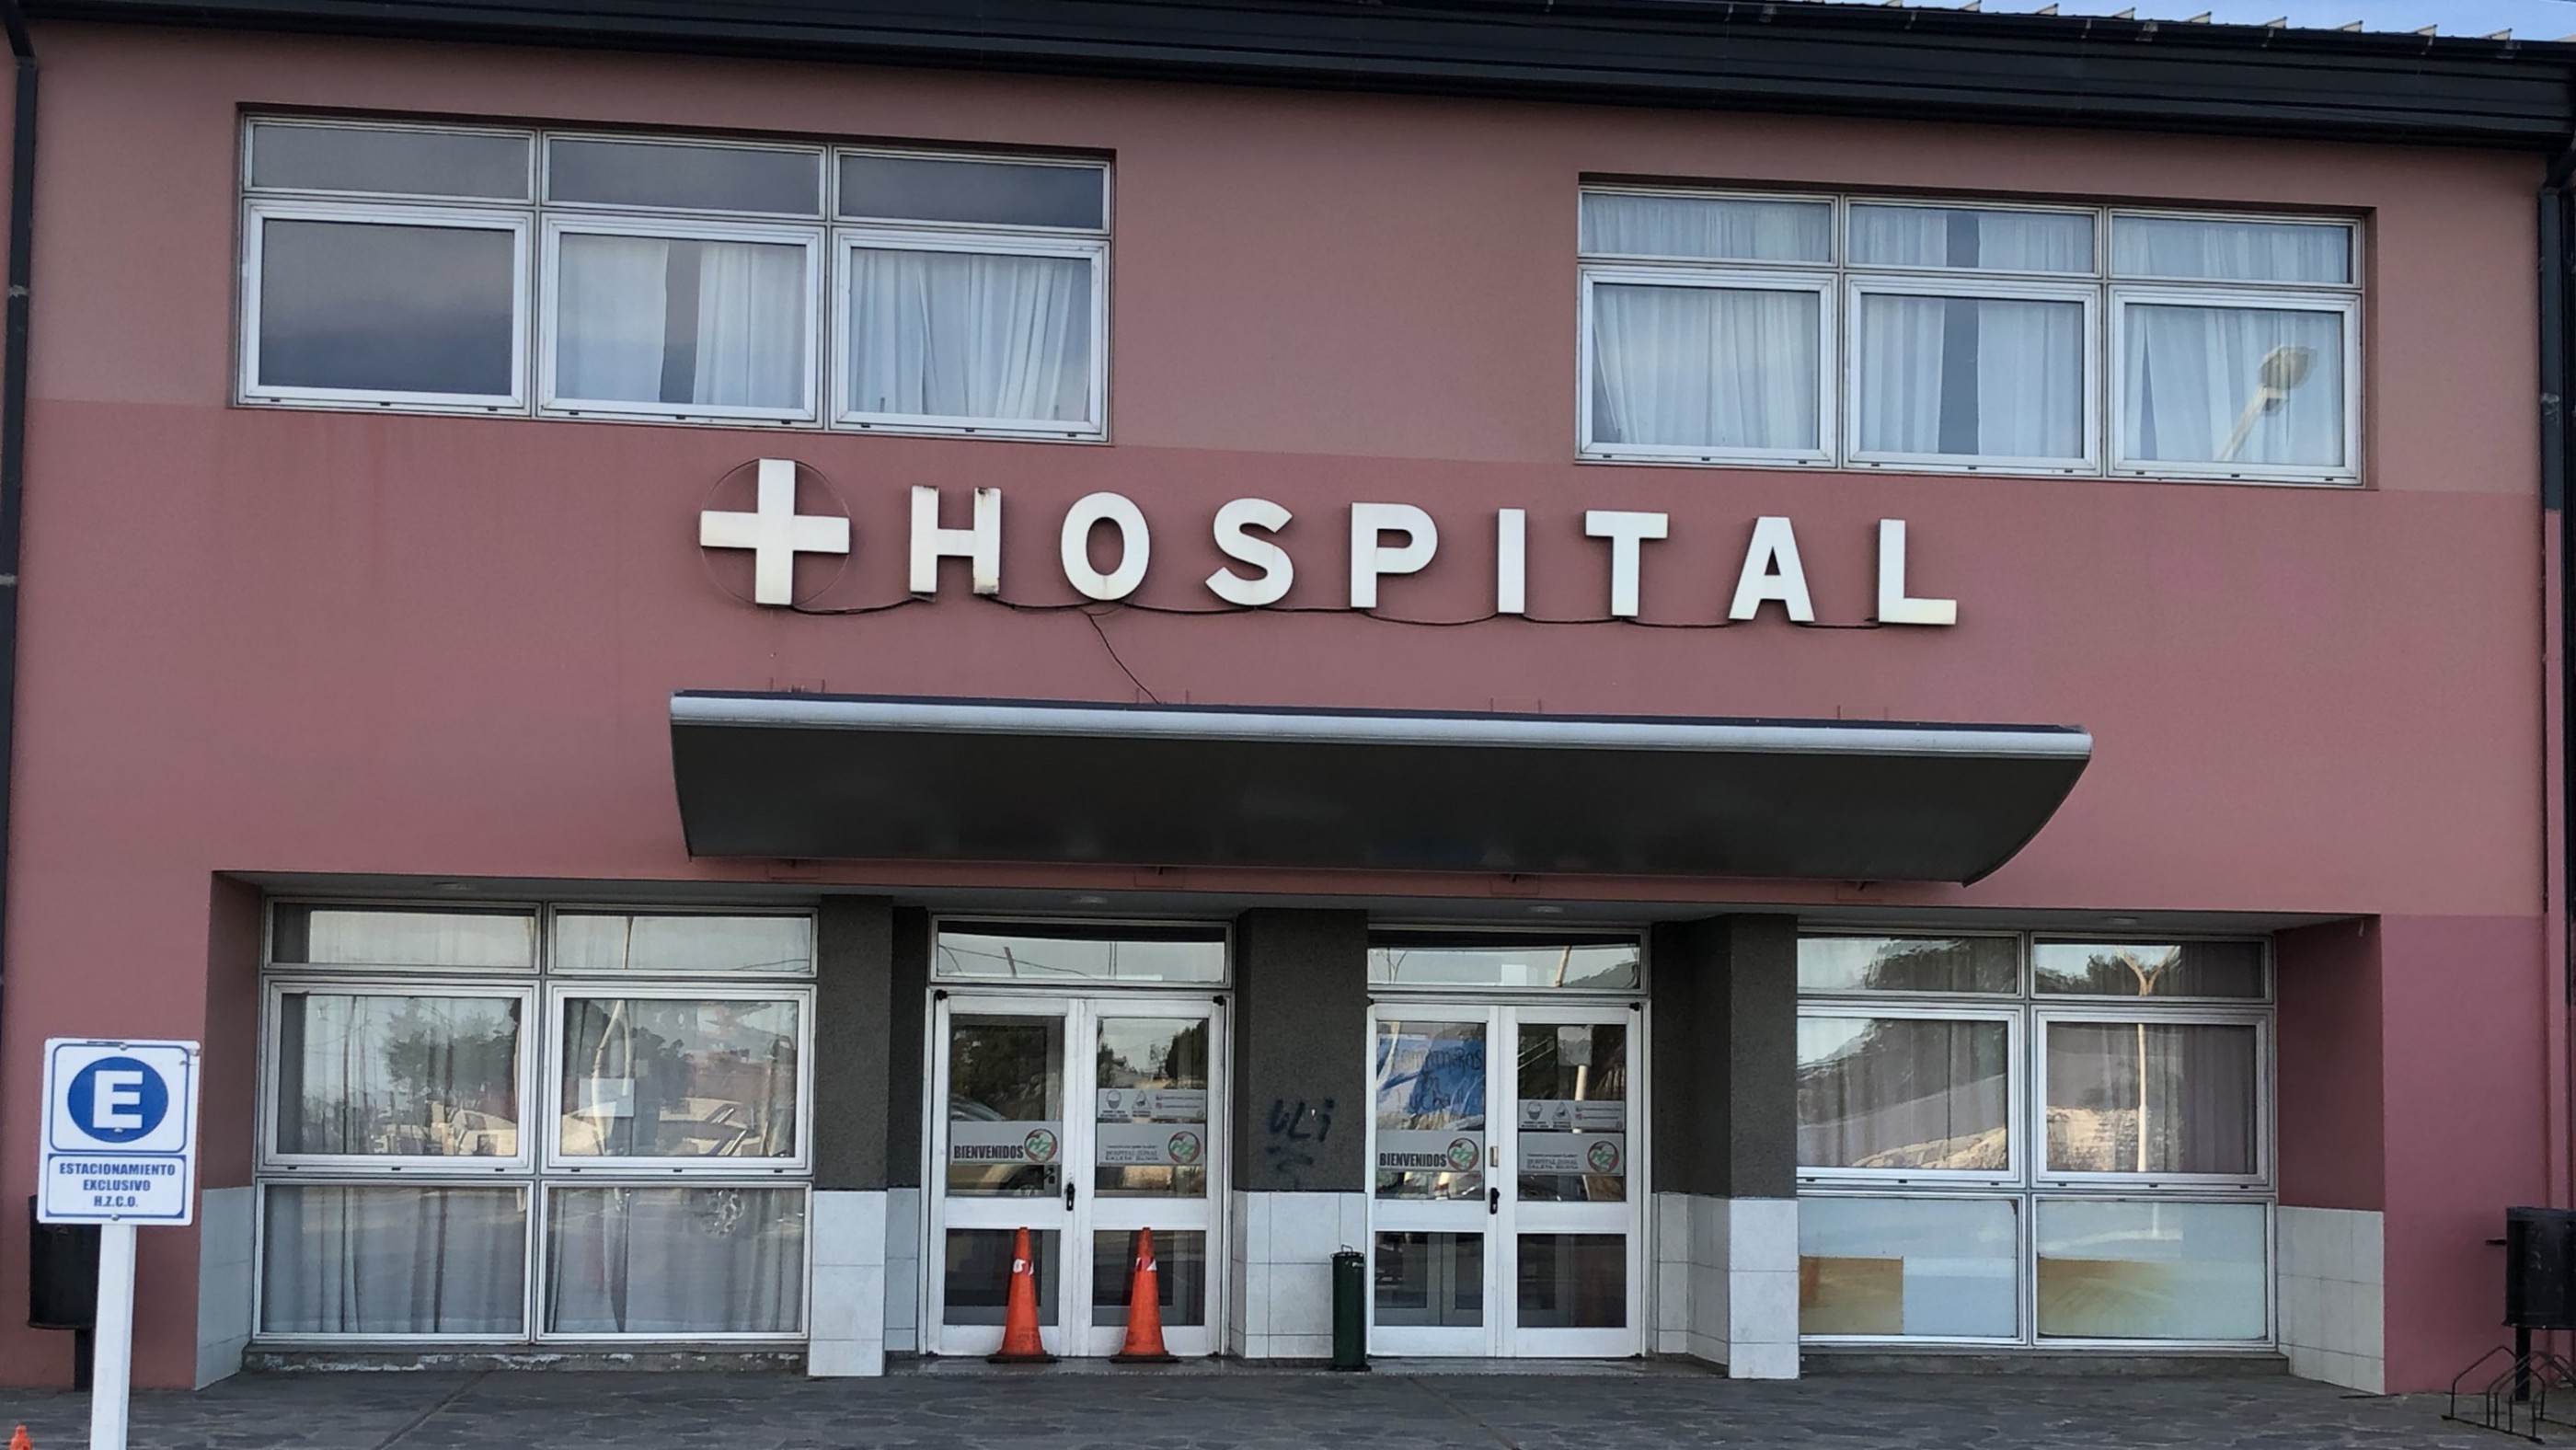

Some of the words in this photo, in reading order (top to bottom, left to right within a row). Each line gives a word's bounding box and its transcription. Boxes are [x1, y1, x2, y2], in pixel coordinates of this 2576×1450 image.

[909, 485, 1958, 626] HOSPITAL
[93, 1070, 144, 1129] E
[954, 1145, 1024, 1159] BIENVENIDOS
[1379, 1153, 1447, 1167] BIENVENIDOS
[59, 1163, 176, 1176] ESTACIONAMIENTO
[83, 1180, 151, 1191] EXCLUSIVO
